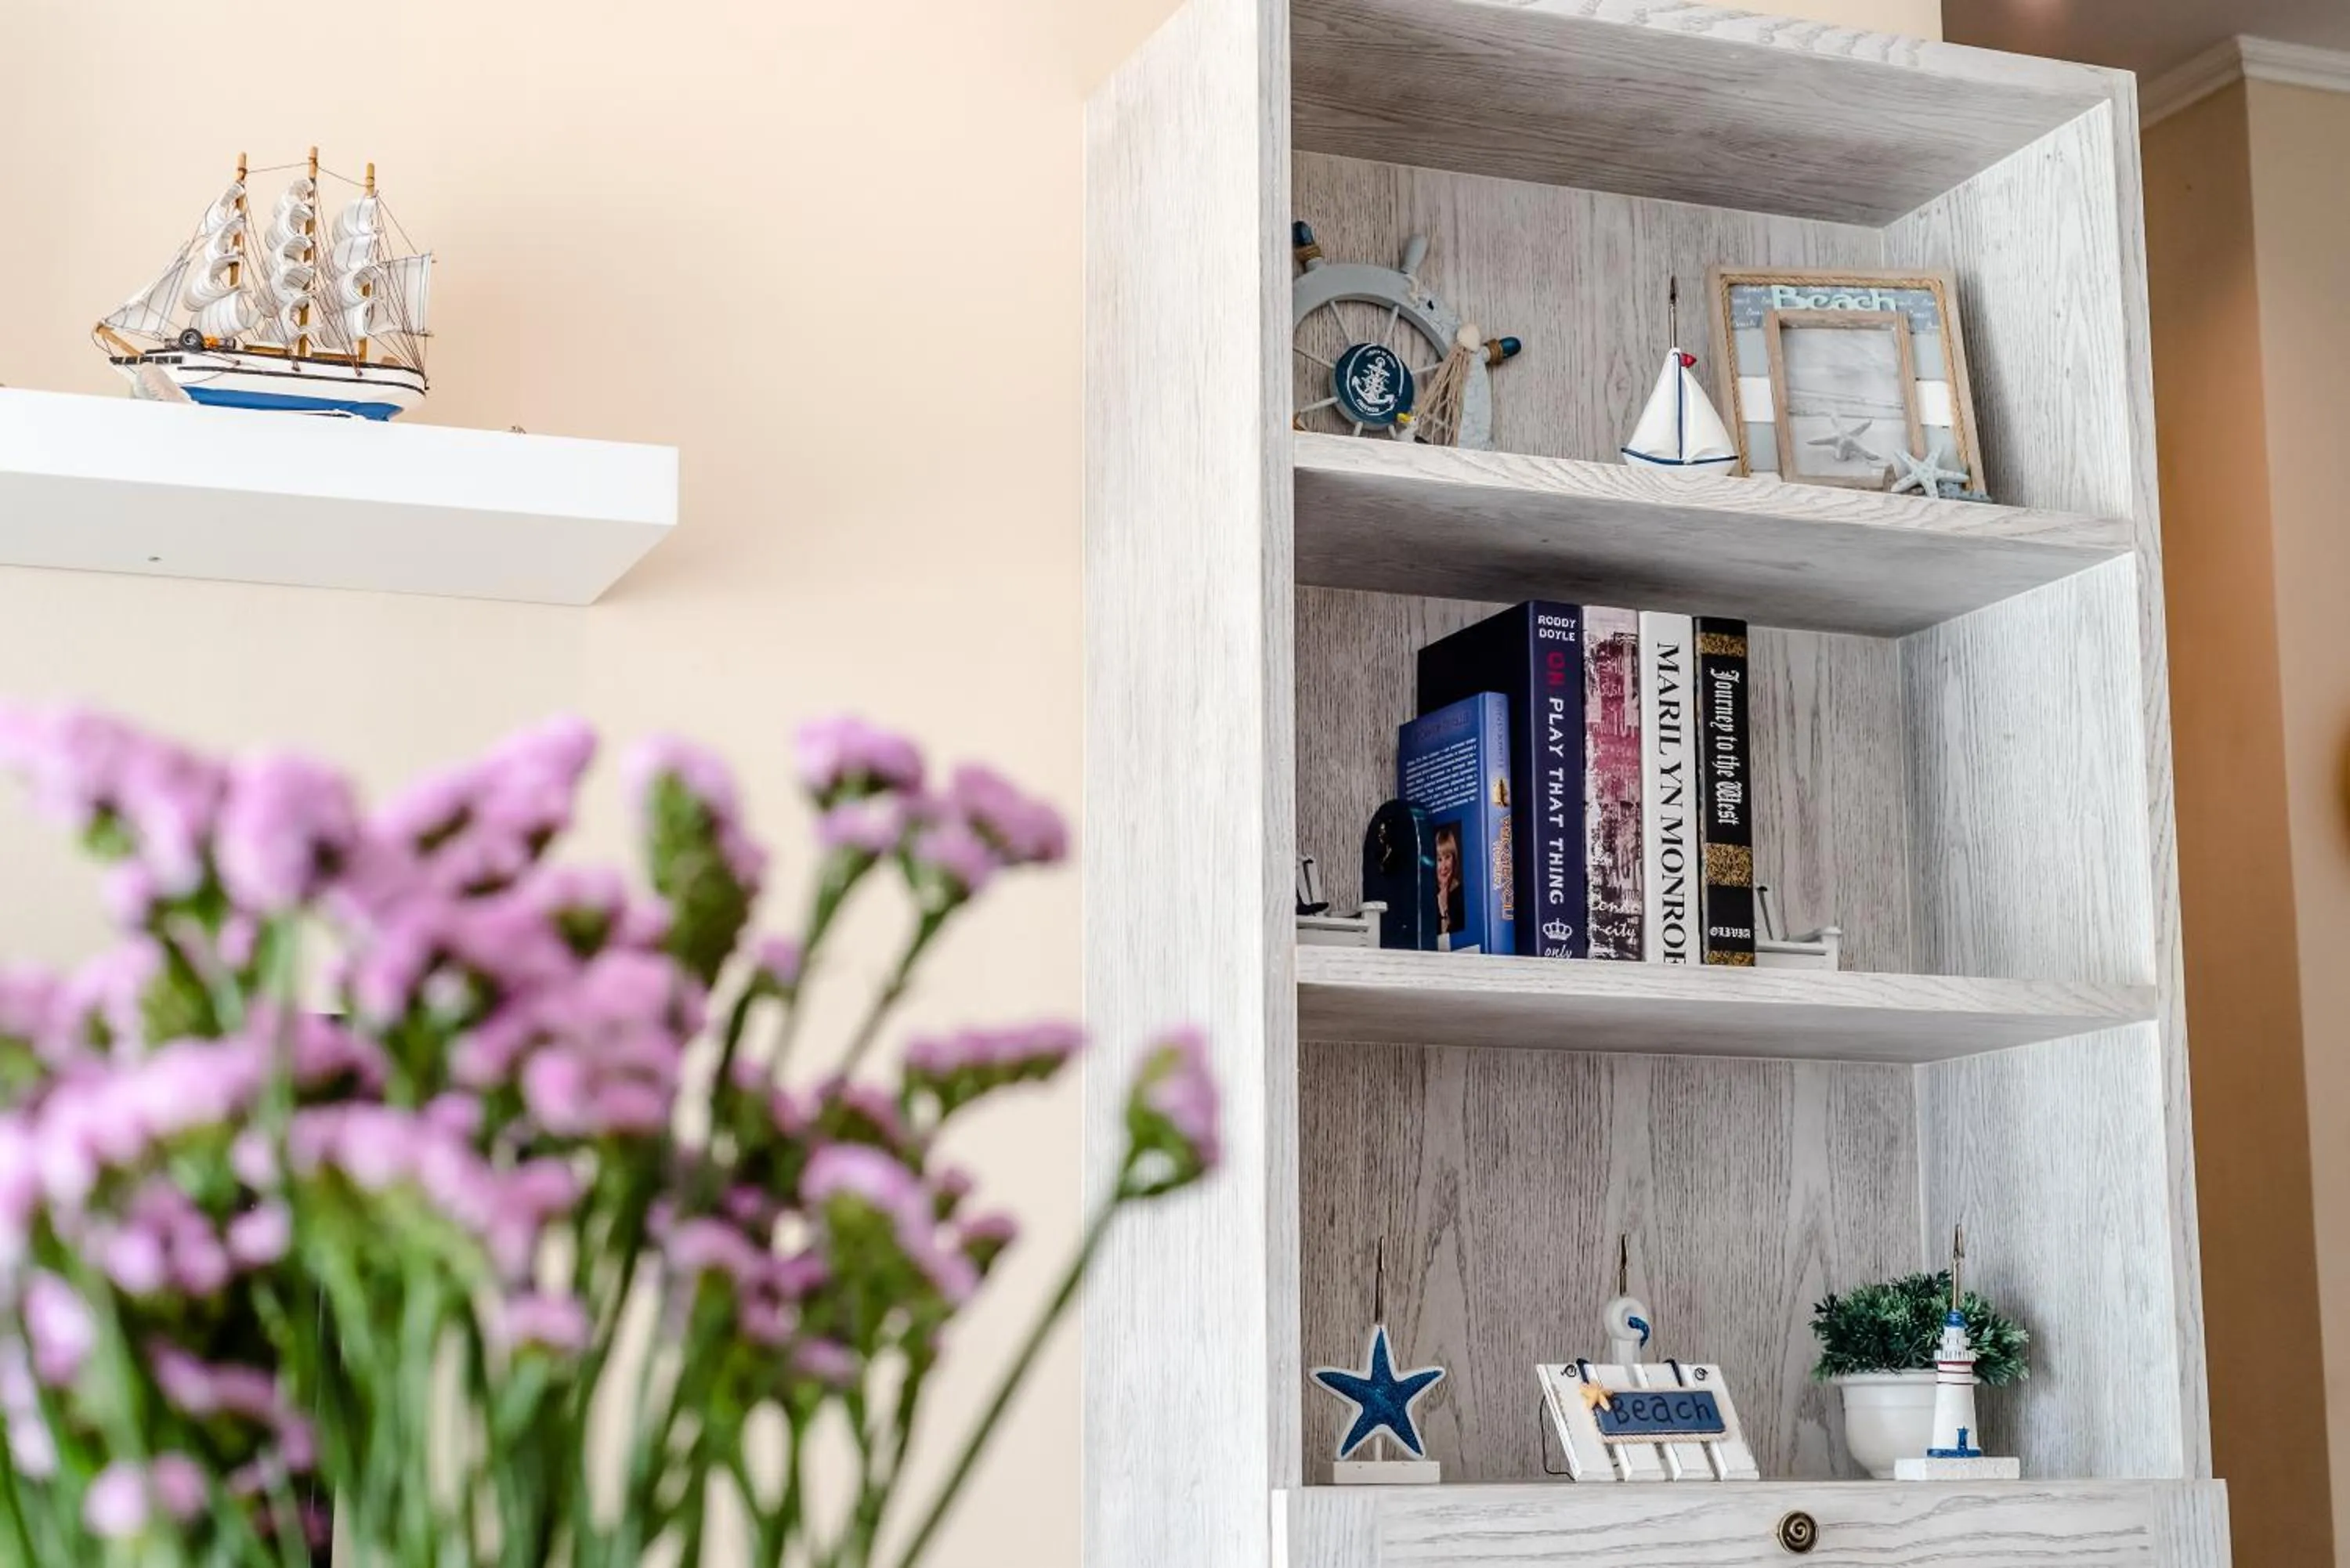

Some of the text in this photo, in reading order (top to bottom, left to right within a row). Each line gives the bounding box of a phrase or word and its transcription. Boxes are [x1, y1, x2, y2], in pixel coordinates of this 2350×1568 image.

[1770, 285, 1896, 312] Beach
[1538, 615, 1576, 629] RODDY
[1539, 628, 1575, 641] DOYLE
[1549, 697, 1564, 757] PLAY
[1710, 667, 1743, 826] Journey to the West
[1549, 768, 1564, 828] THAT
[1658, 642, 1687, 965] MARILYN MONROE
[1549, 838, 1564, 905] THING
[1612, 1394, 1712, 1425] Beach
